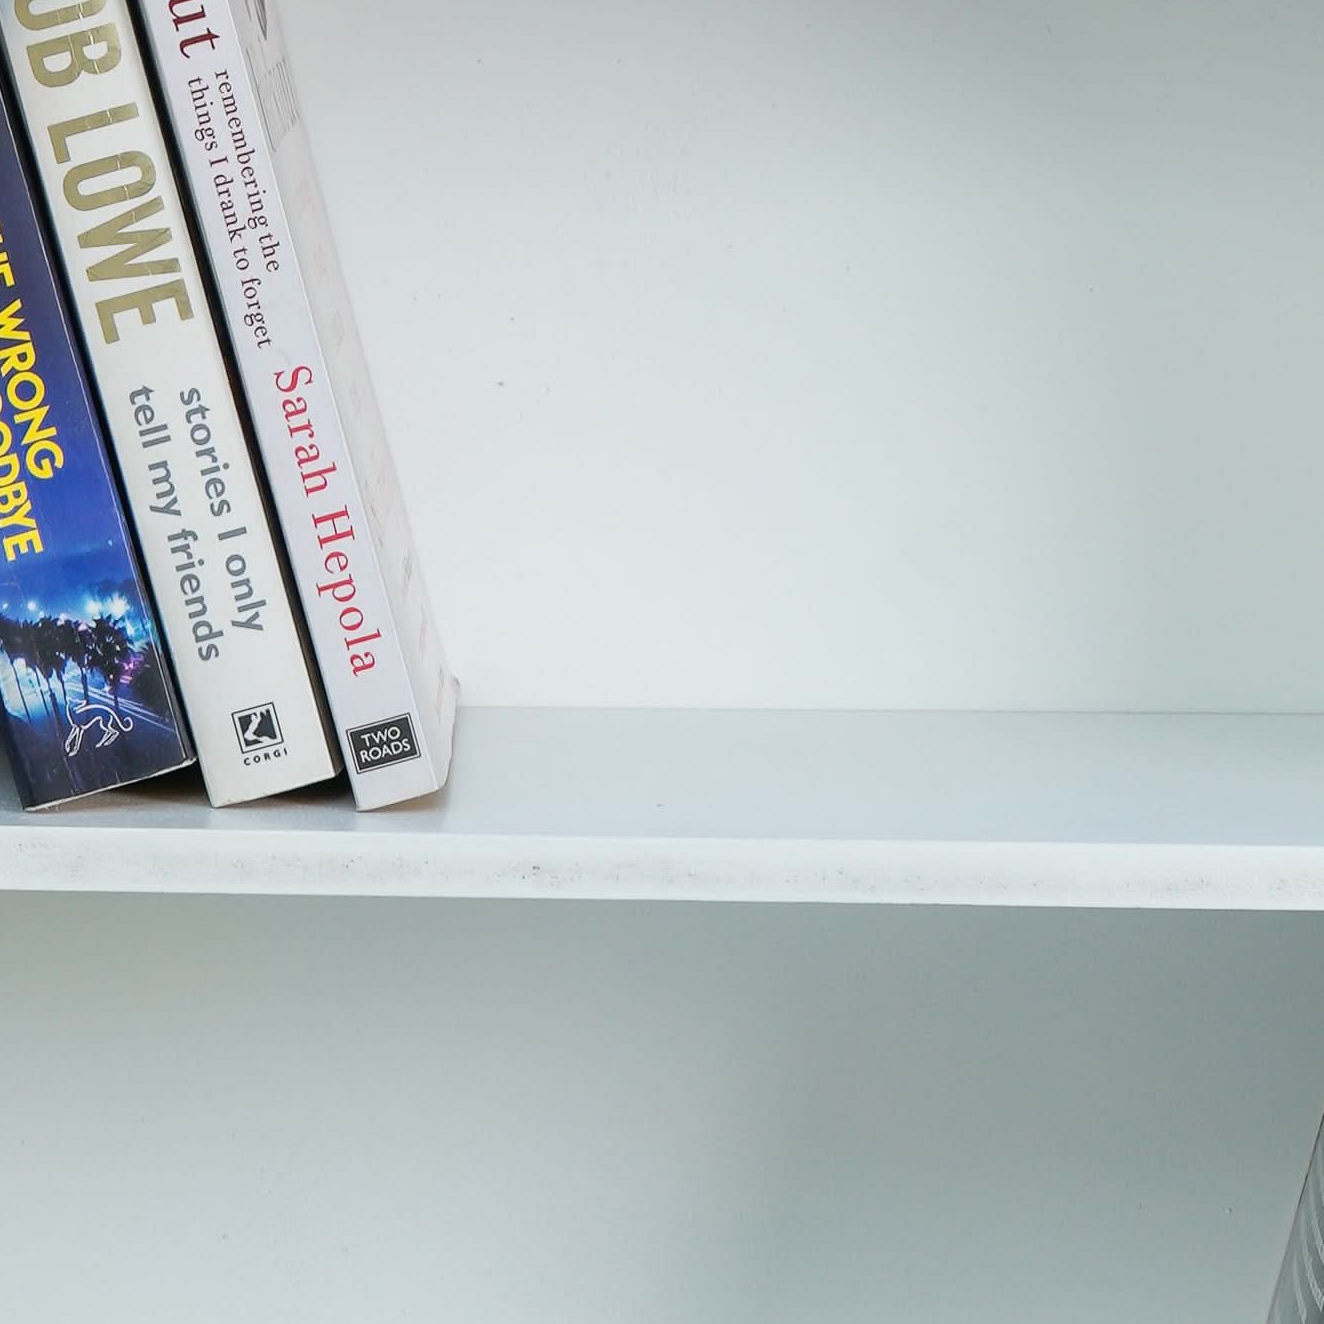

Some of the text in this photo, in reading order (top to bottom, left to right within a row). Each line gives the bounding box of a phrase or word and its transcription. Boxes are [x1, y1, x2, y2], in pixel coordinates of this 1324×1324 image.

[47, 102, 194, 345] LOWE
[188, 76, 273, 349] things I drank to forget
[215, 68, 280, 272] remembering the
[128, 385, 224, 662] tell my friends
[180, 387, 267, 634] stories I only
[274, 365, 382, 677] Sarah Hepola
[243, 748, 289, 766] CORGI
[359, 737, 412, 762] ROADS
[361, 728, 401, 747] TWO
